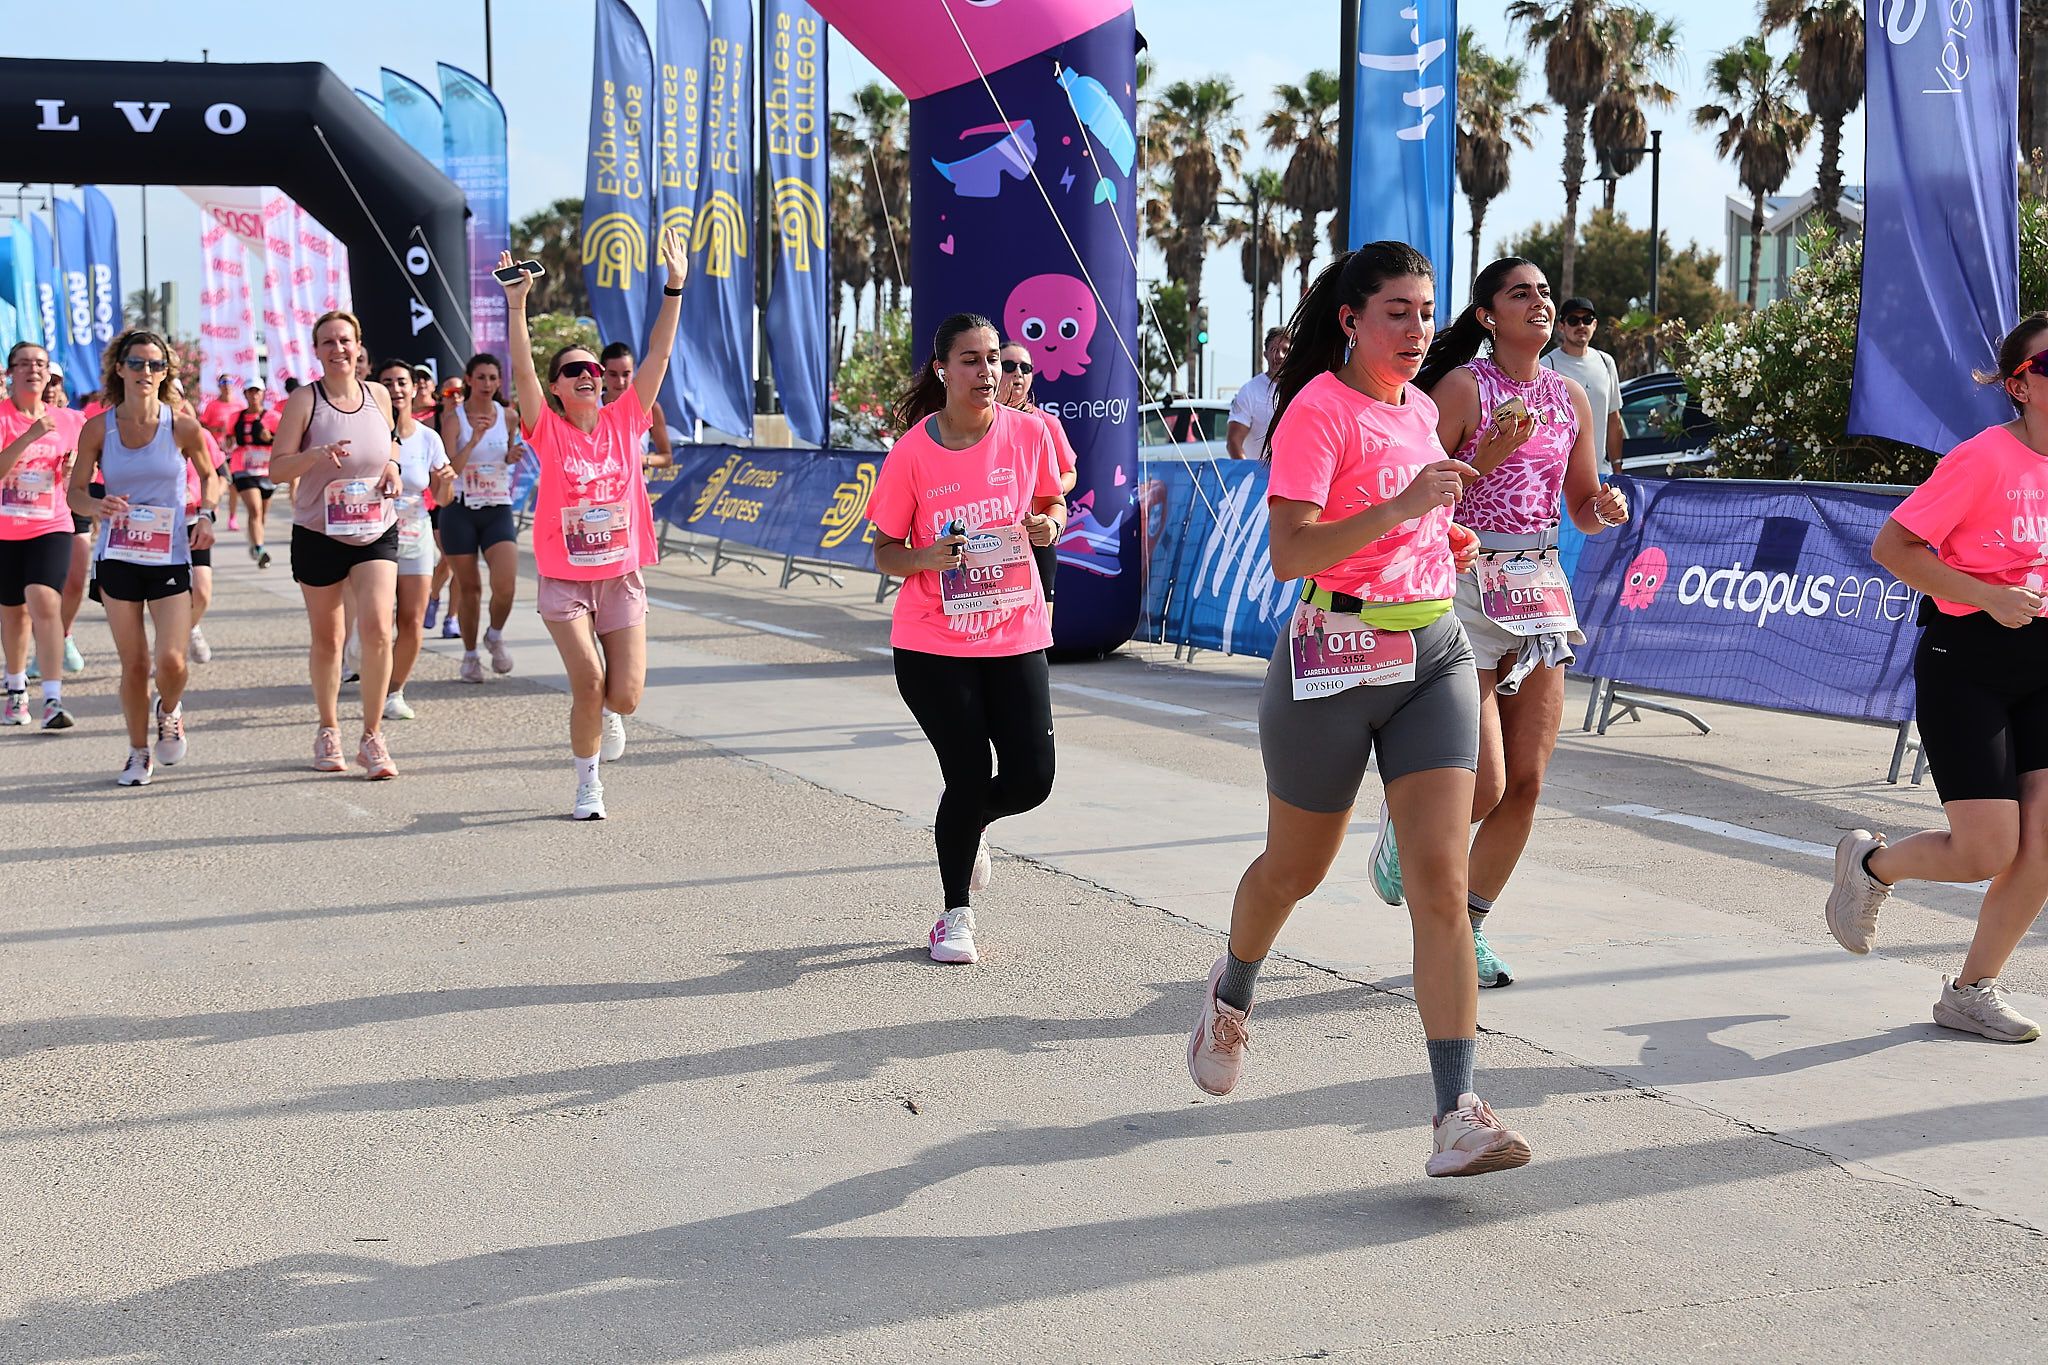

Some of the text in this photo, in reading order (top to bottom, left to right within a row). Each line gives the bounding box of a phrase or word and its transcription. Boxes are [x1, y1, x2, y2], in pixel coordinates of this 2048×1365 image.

[1063, 398, 1130, 425] energy
[732, 461, 783, 489] Correos
[926, 483, 961, 499] OYSHO
[2006, 489, 2044, 500] OYSHO
[345, 503, 369, 514] 016
[712, 490, 764, 525] Express
[586, 532, 612, 544] 016
[966, 541, 1000, 551] ASTURIANA
[970, 565, 1004, 582] 016
[981, 582, 997, 590] 1944
[1677, 561, 1835, 628] octopus
[1511, 588, 1544, 605] 016
[953, 601, 982, 610] OYSHO
[1327, 631, 1376, 653] 016
[1303, 667, 1331, 677] CARRERA
[1350, 664, 1372, 673] MUJER
[1376, 658, 1403, 669] VALENCIA
[1342, 654, 1365, 664] 3152
[1305, 671, 1402, 692] OYSHO Santander
